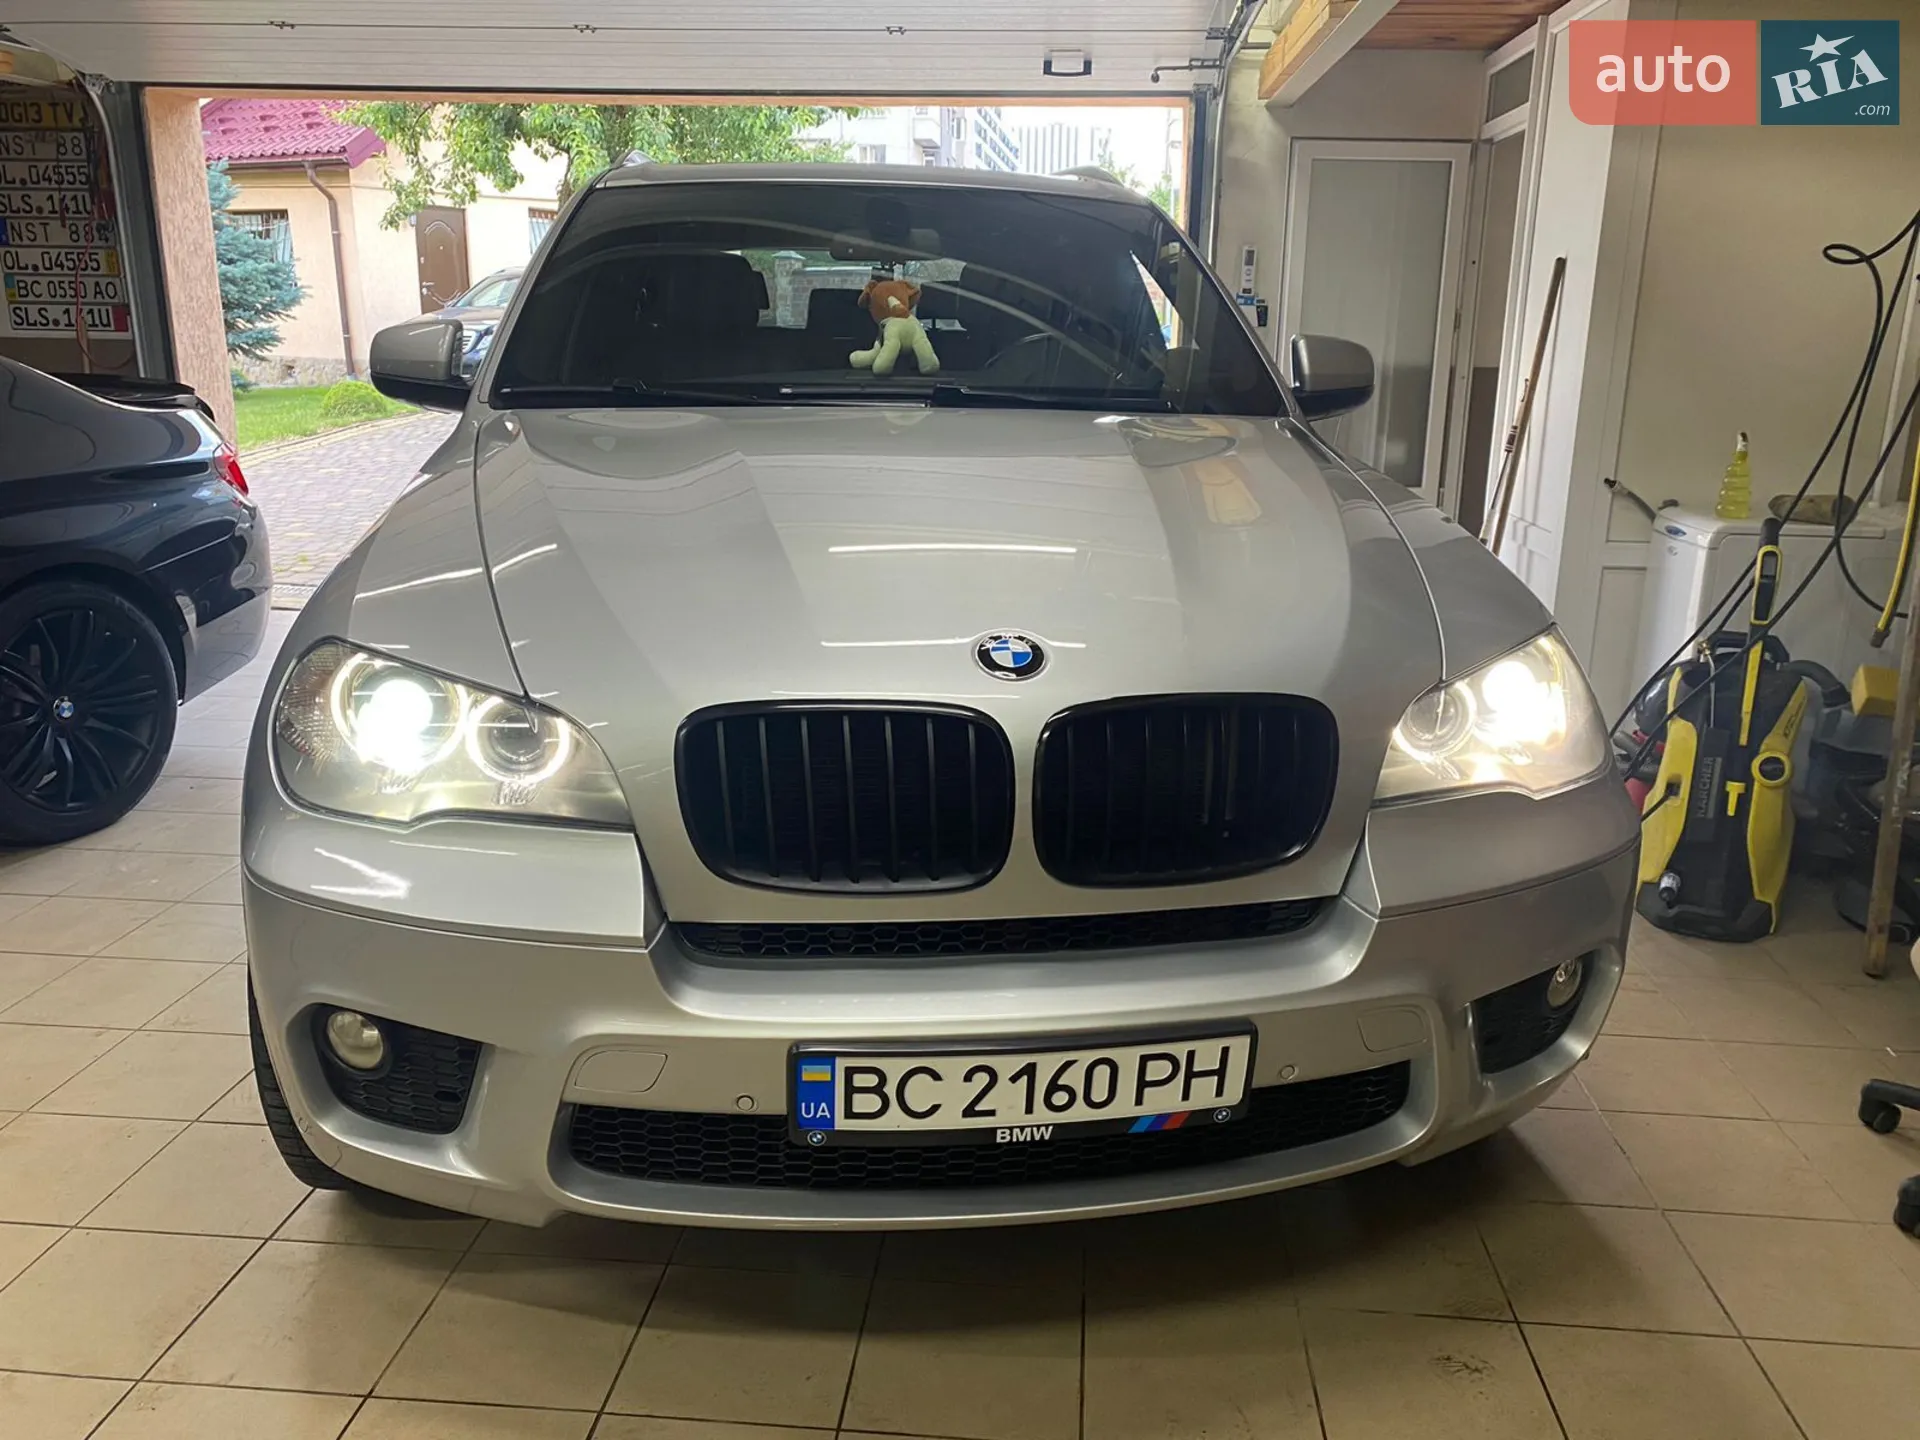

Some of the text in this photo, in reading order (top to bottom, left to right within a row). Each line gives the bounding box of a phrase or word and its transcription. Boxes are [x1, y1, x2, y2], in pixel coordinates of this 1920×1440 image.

[10, 222, 50, 243] NST
[16, 280, 42, 298] BC
[94, 281, 117, 299] AO
[844, 1045, 1231, 1120] BC 2160 PH
[801, 1102, 831, 1119] UA
[995, 1125, 1053, 1144] BMW
